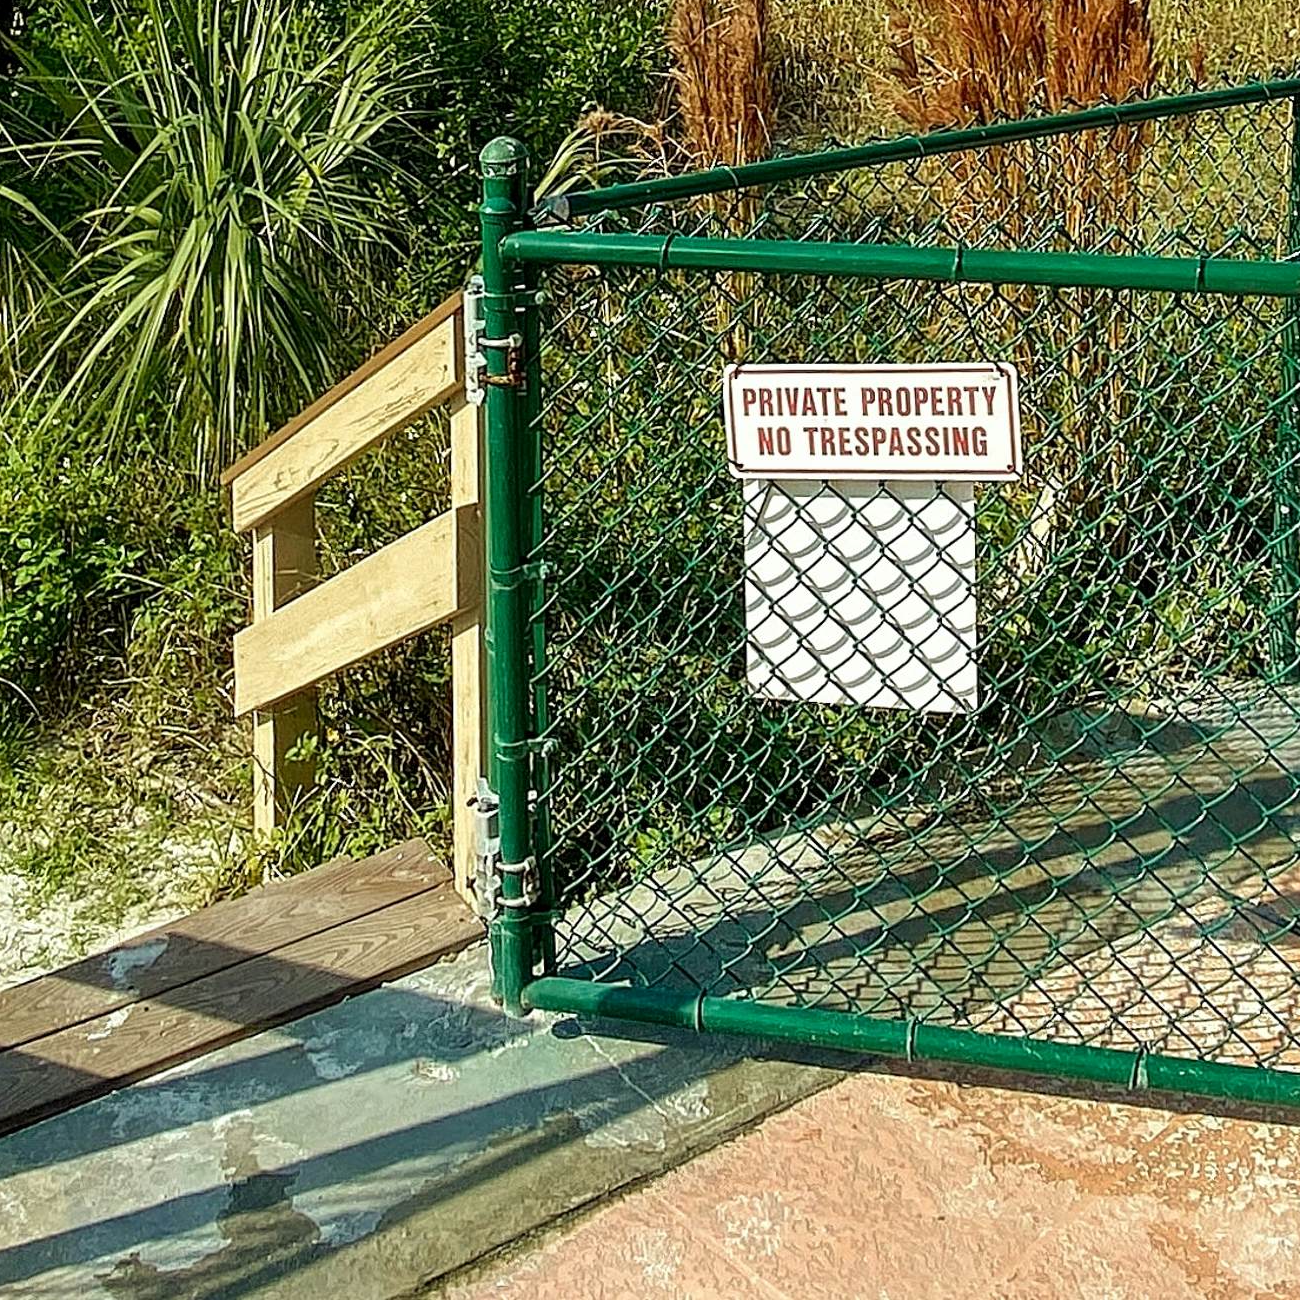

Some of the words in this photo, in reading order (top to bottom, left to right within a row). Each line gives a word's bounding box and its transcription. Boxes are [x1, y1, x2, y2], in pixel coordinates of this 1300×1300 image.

[742, 387, 848, 417] PRIVATE
[861, 386, 997, 417] PROPERTY
[757, 426, 791, 457] NO
[803, 426, 988, 457] TRESPASSING
